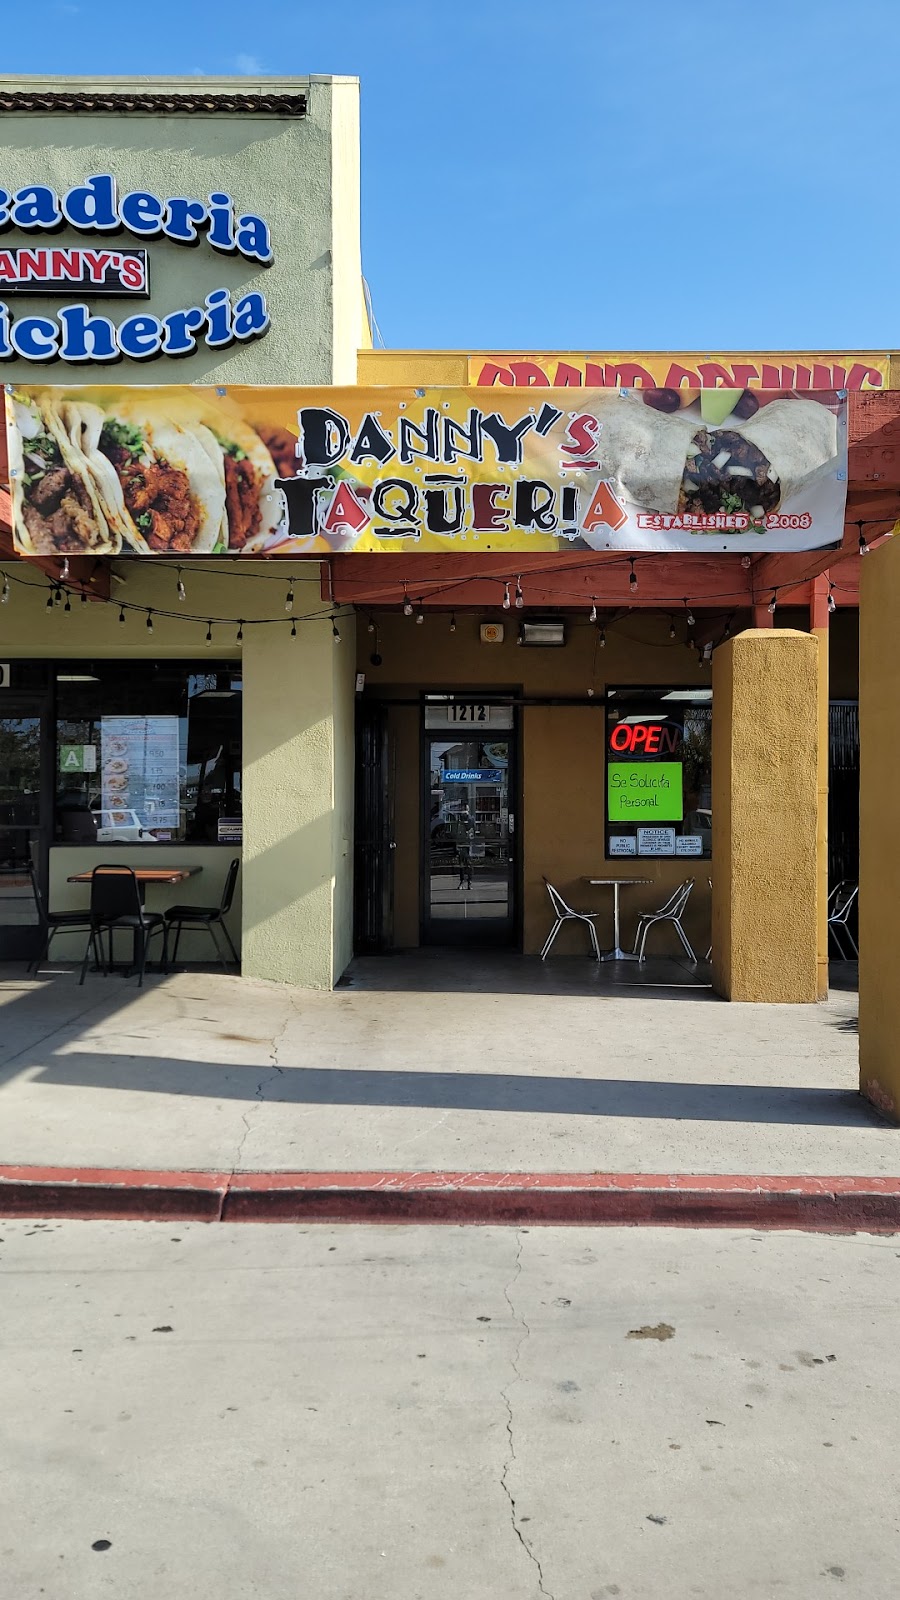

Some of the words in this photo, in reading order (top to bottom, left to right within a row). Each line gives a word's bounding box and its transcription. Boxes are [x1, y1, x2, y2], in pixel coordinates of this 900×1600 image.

[0, 173, 274, 262] aderia
[297, 403, 602, 469] DANNY'S
[273, 475, 628, 537] TAQUERIA
[637, 512, 749, 530] ESTABLISHED
[766, 513, 812, 530] 2008
[451, 704, 486, 721] 1212
[610, 724, 679, 753] OPEN
[64, 751, 80, 767] A
[445, 772, 461, 780] Cold
[461, 772, 482, 780] Drinks
[610, 773, 627, 788] Se
[620, 794, 659, 809] Personal
